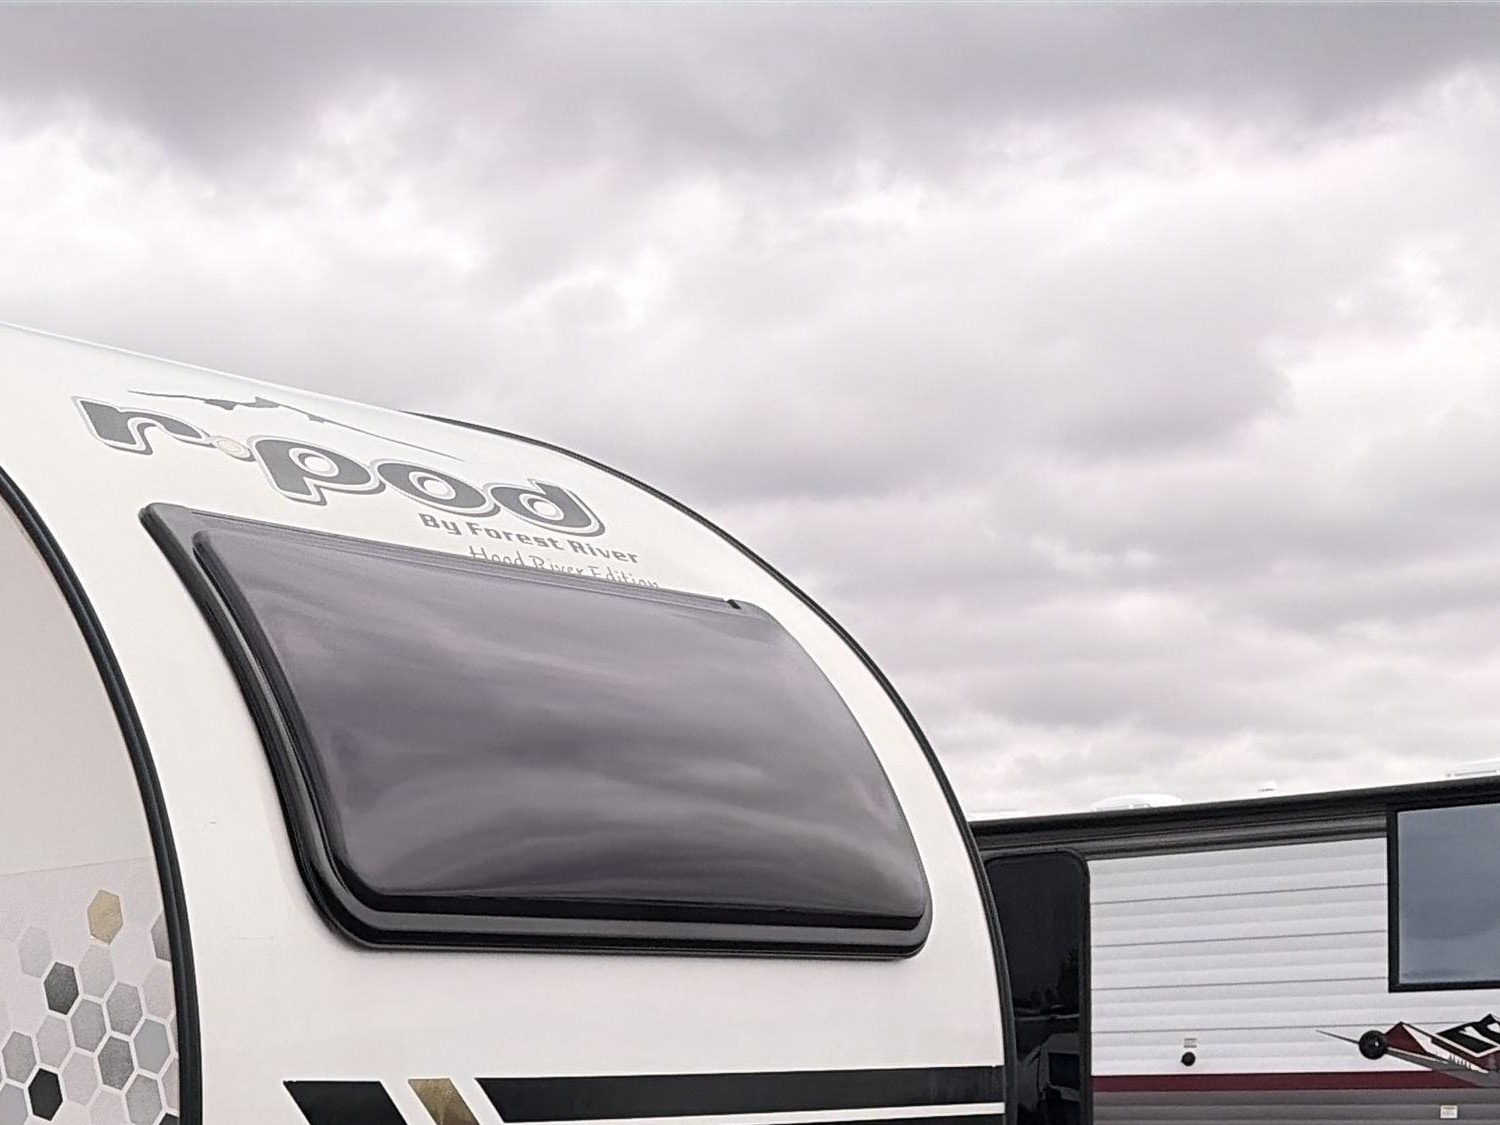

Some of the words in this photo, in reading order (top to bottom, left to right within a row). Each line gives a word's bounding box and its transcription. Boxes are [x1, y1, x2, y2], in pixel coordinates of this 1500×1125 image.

[418, 513, 462, 536] By
[468, 522, 565, 550] Forest
[566, 539, 639, 564] River
